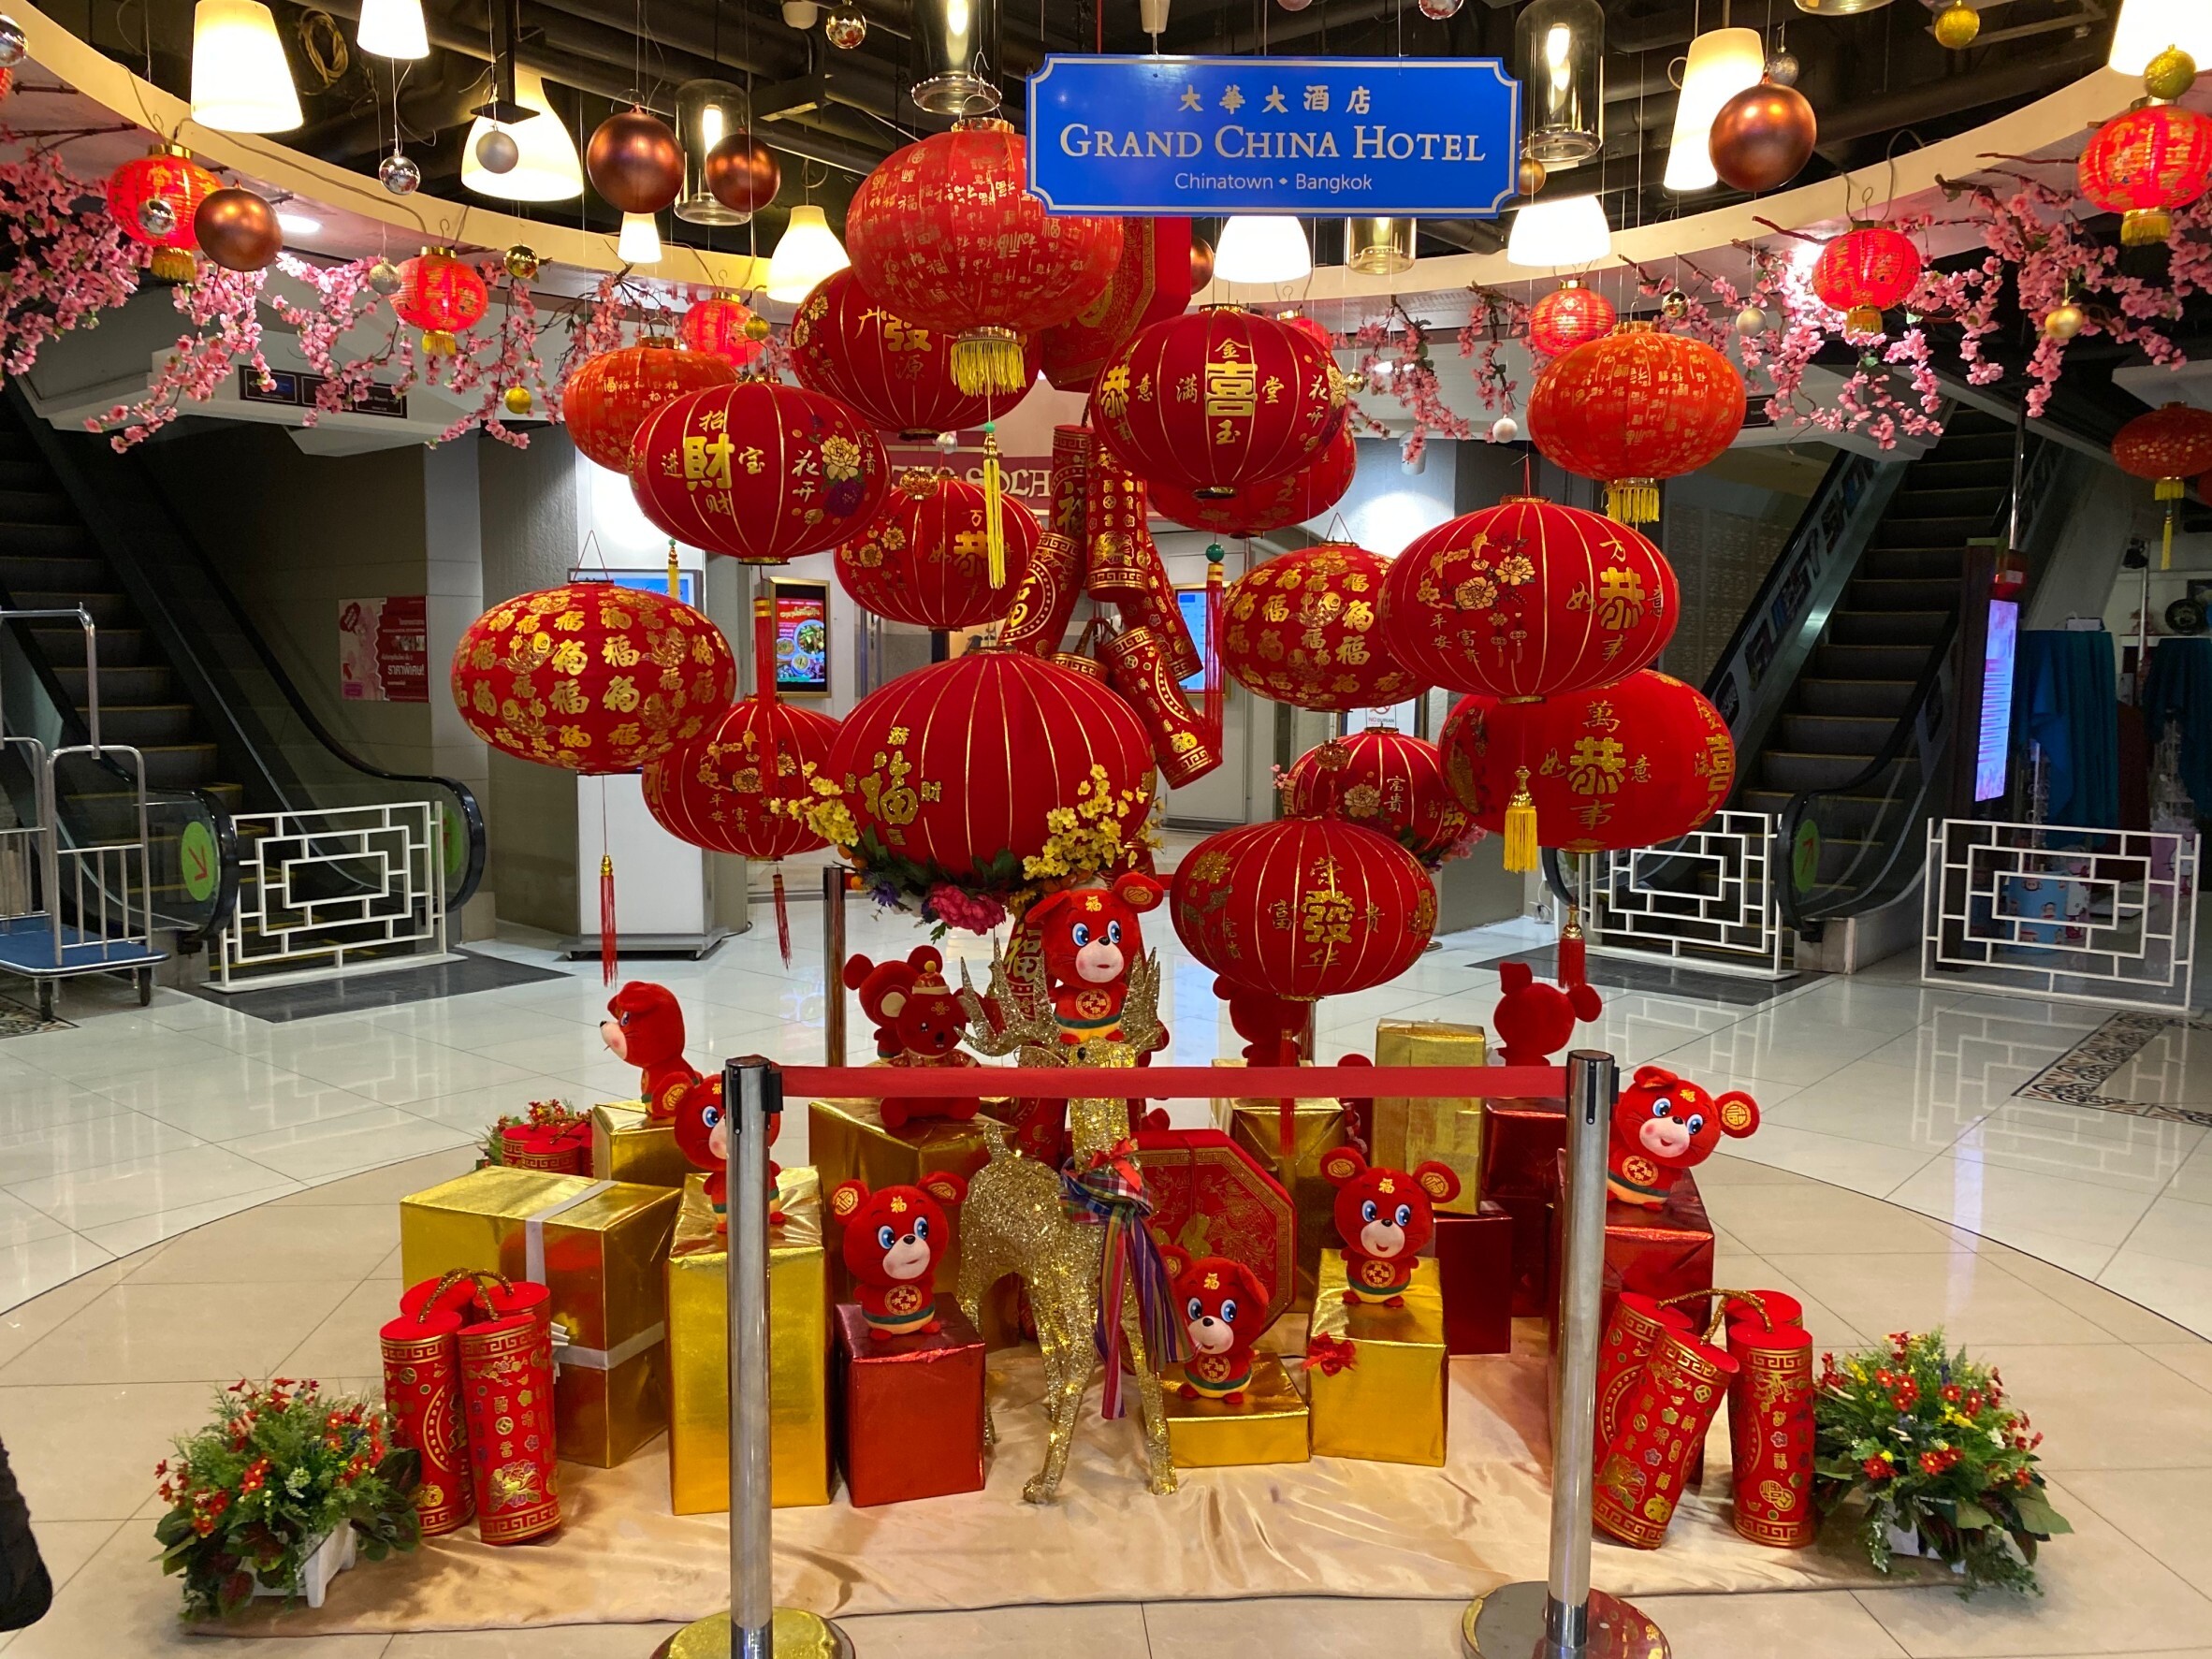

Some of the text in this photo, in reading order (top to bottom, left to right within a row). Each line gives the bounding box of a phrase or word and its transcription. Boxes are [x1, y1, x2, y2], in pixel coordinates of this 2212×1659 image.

[1178, 85, 1372, 115] 大華大酒店
[1060, 124, 1486, 162] GRAND CHINA HOTEL
[1175, 172, 1373, 195] Chinatown Bangkok
